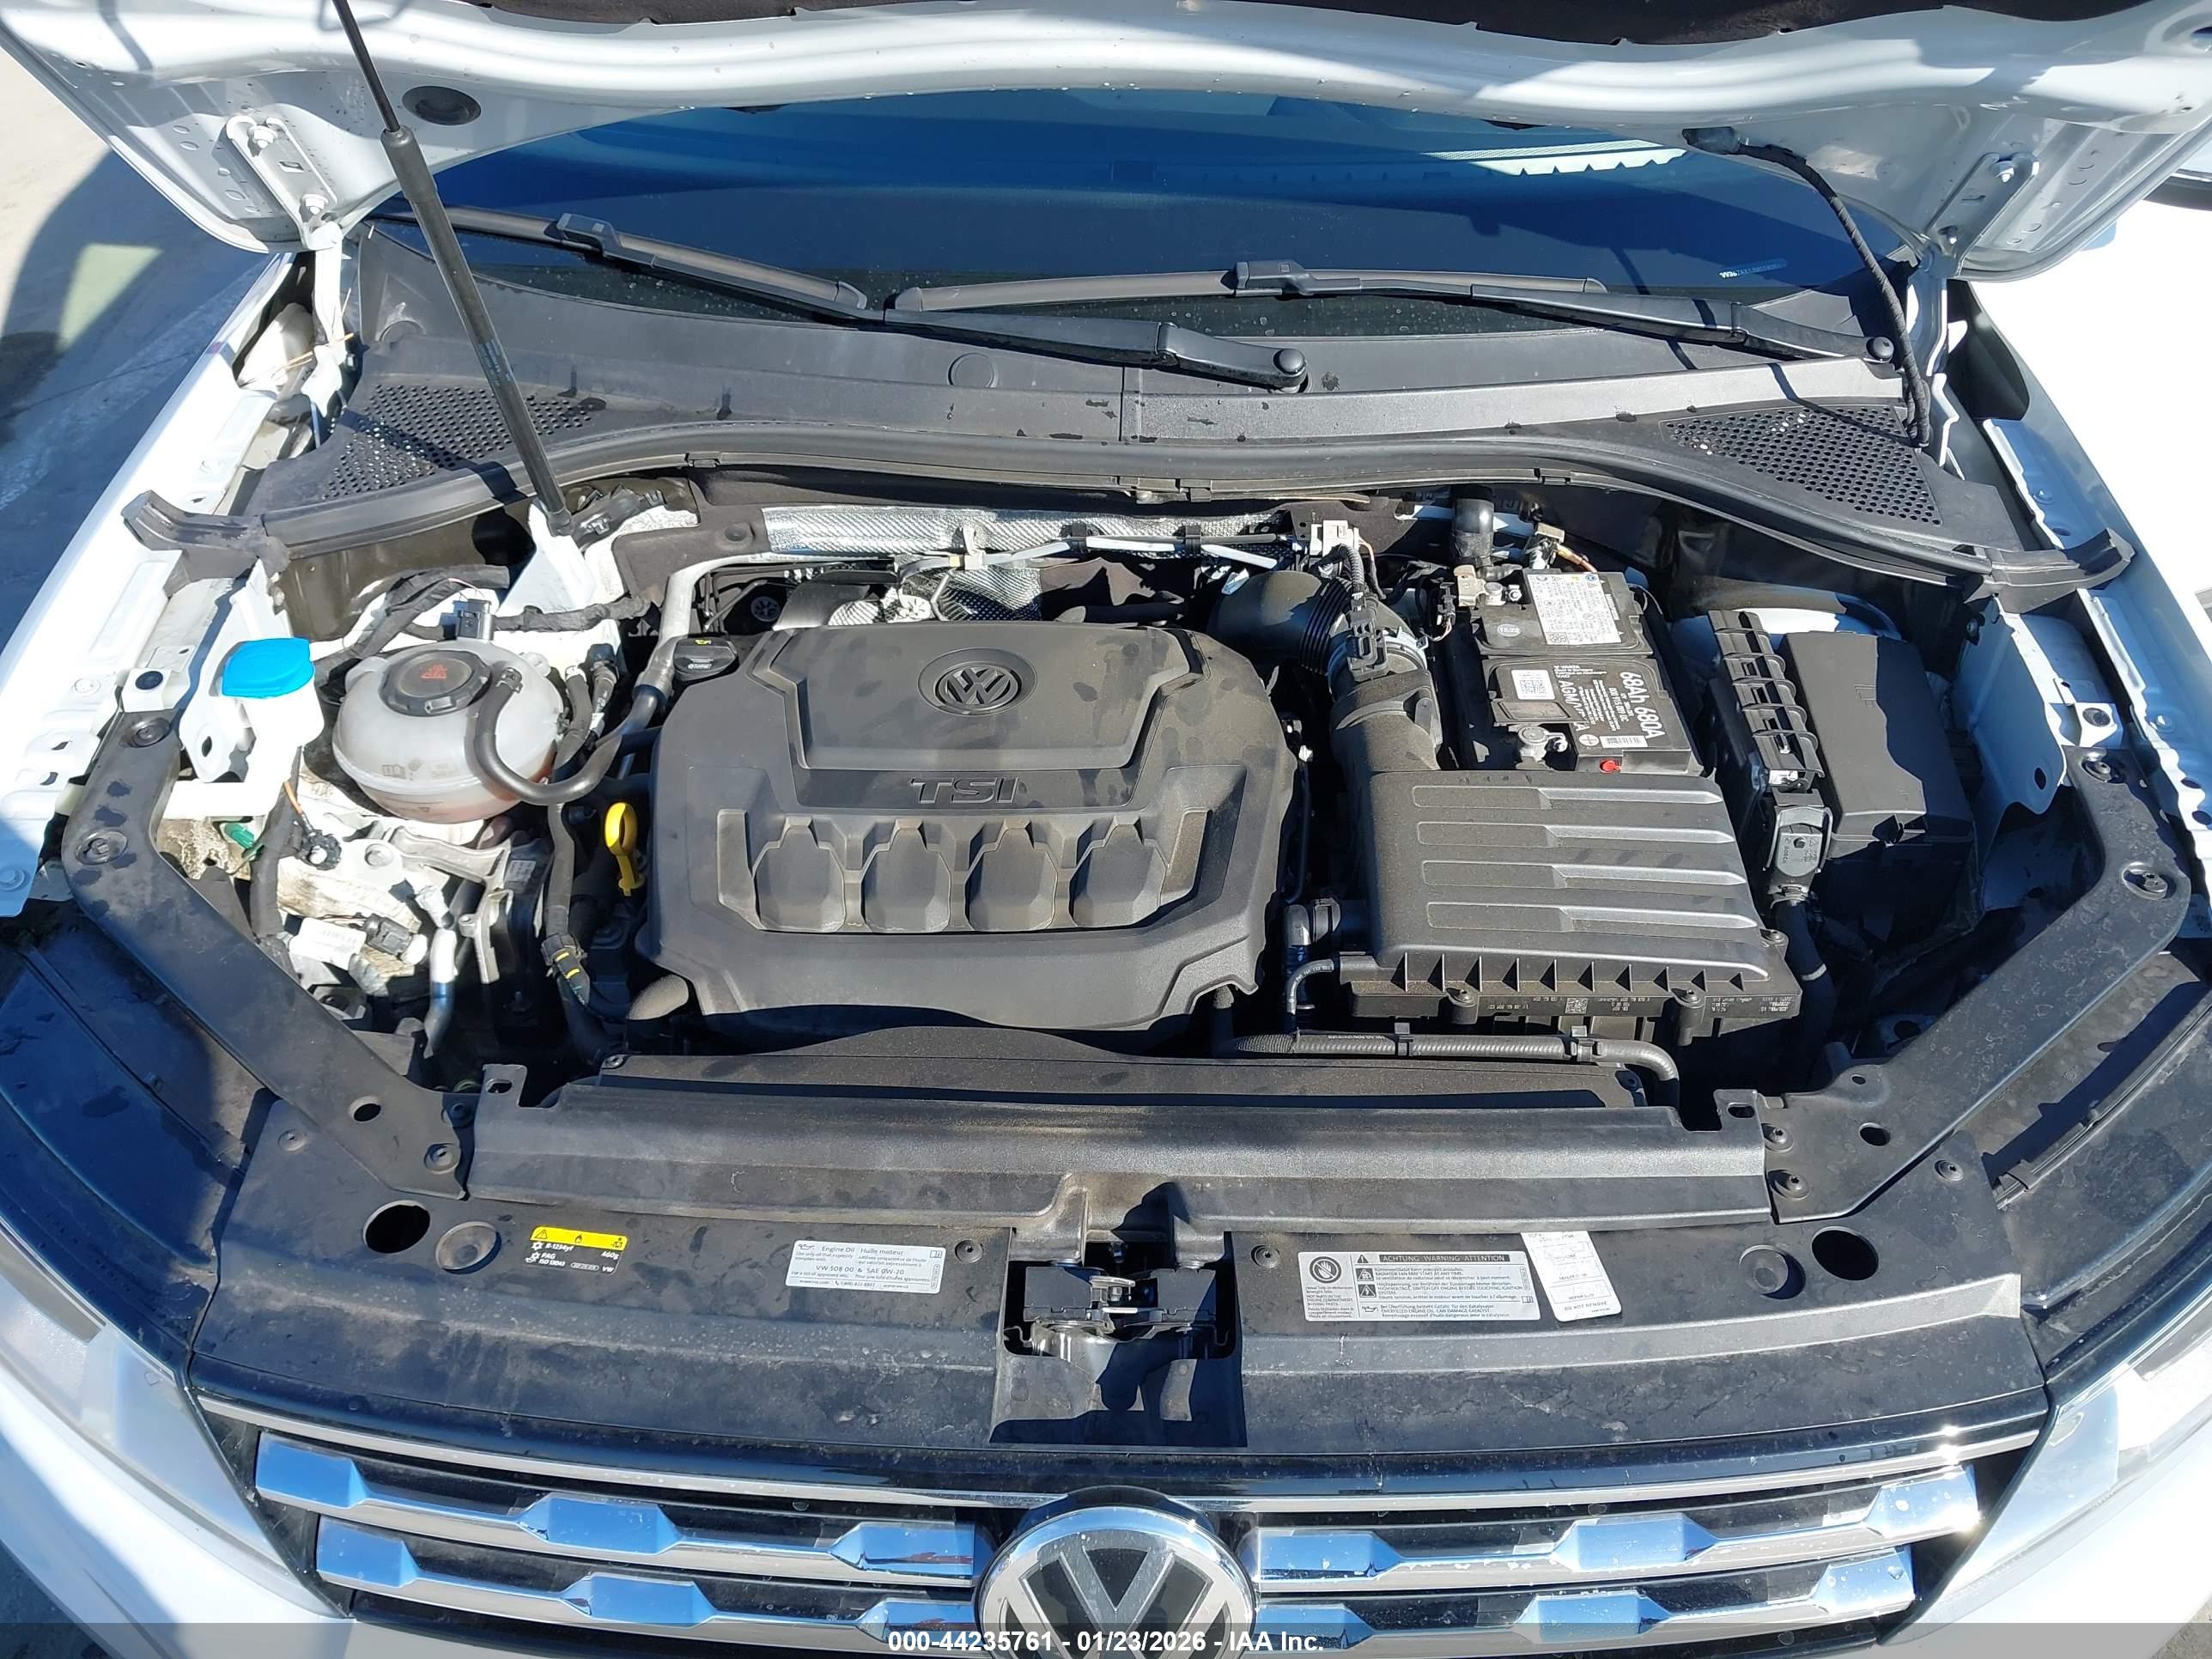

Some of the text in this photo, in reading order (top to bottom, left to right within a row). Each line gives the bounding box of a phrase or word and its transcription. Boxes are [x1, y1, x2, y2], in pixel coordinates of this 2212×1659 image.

[1620, 672, 1650, 703] 68Ah
[1634, 707, 1665, 738] 680A
[908, 777, 1019, 804] TSI
[601, 1251, 619, 1260] 460g
